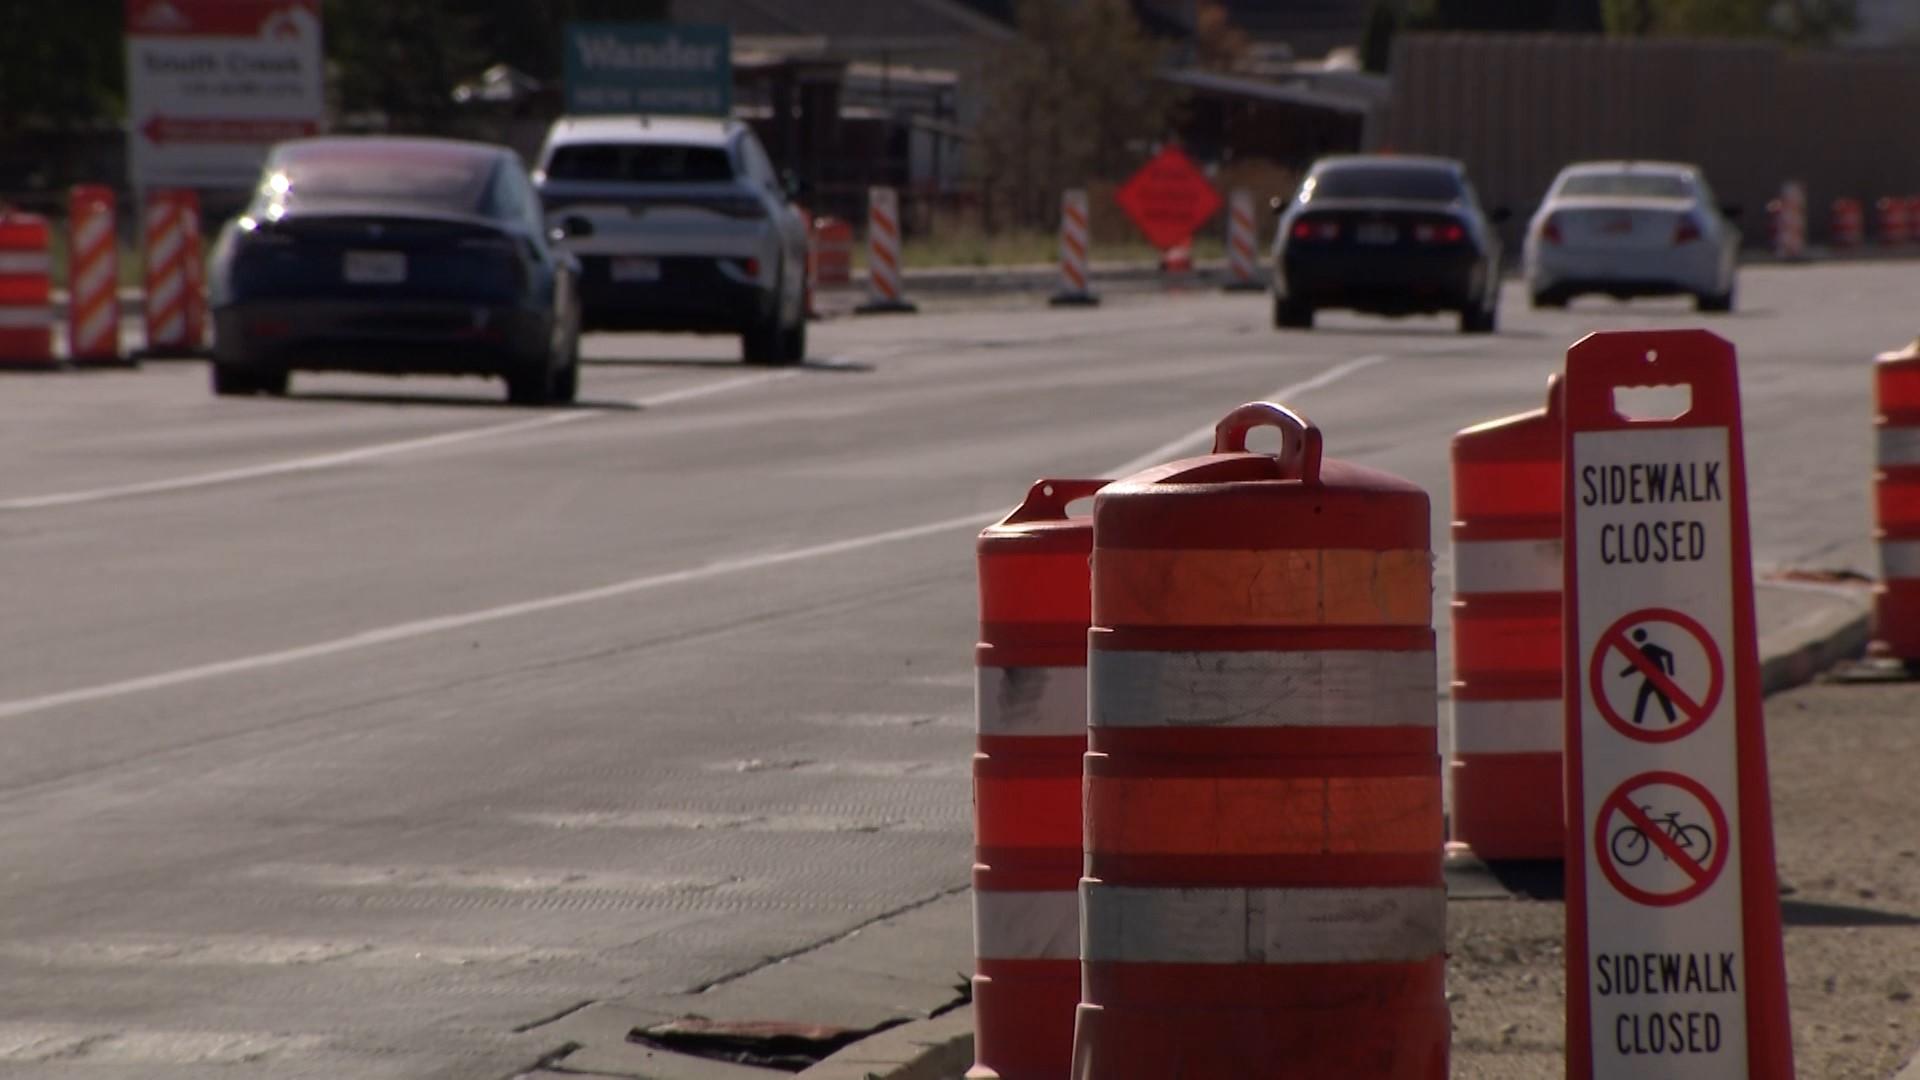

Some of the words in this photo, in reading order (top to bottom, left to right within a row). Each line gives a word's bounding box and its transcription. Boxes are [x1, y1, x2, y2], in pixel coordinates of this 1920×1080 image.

[576, 33, 720, 72] Wander
[1582, 461, 1722, 507] SIDEWALK
[1601, 520, 1706, 565] CLOSED
[1596, 952, 1738, 996] SIDEWALK
[1616, 1011, 1721, 1056] CLOSED
